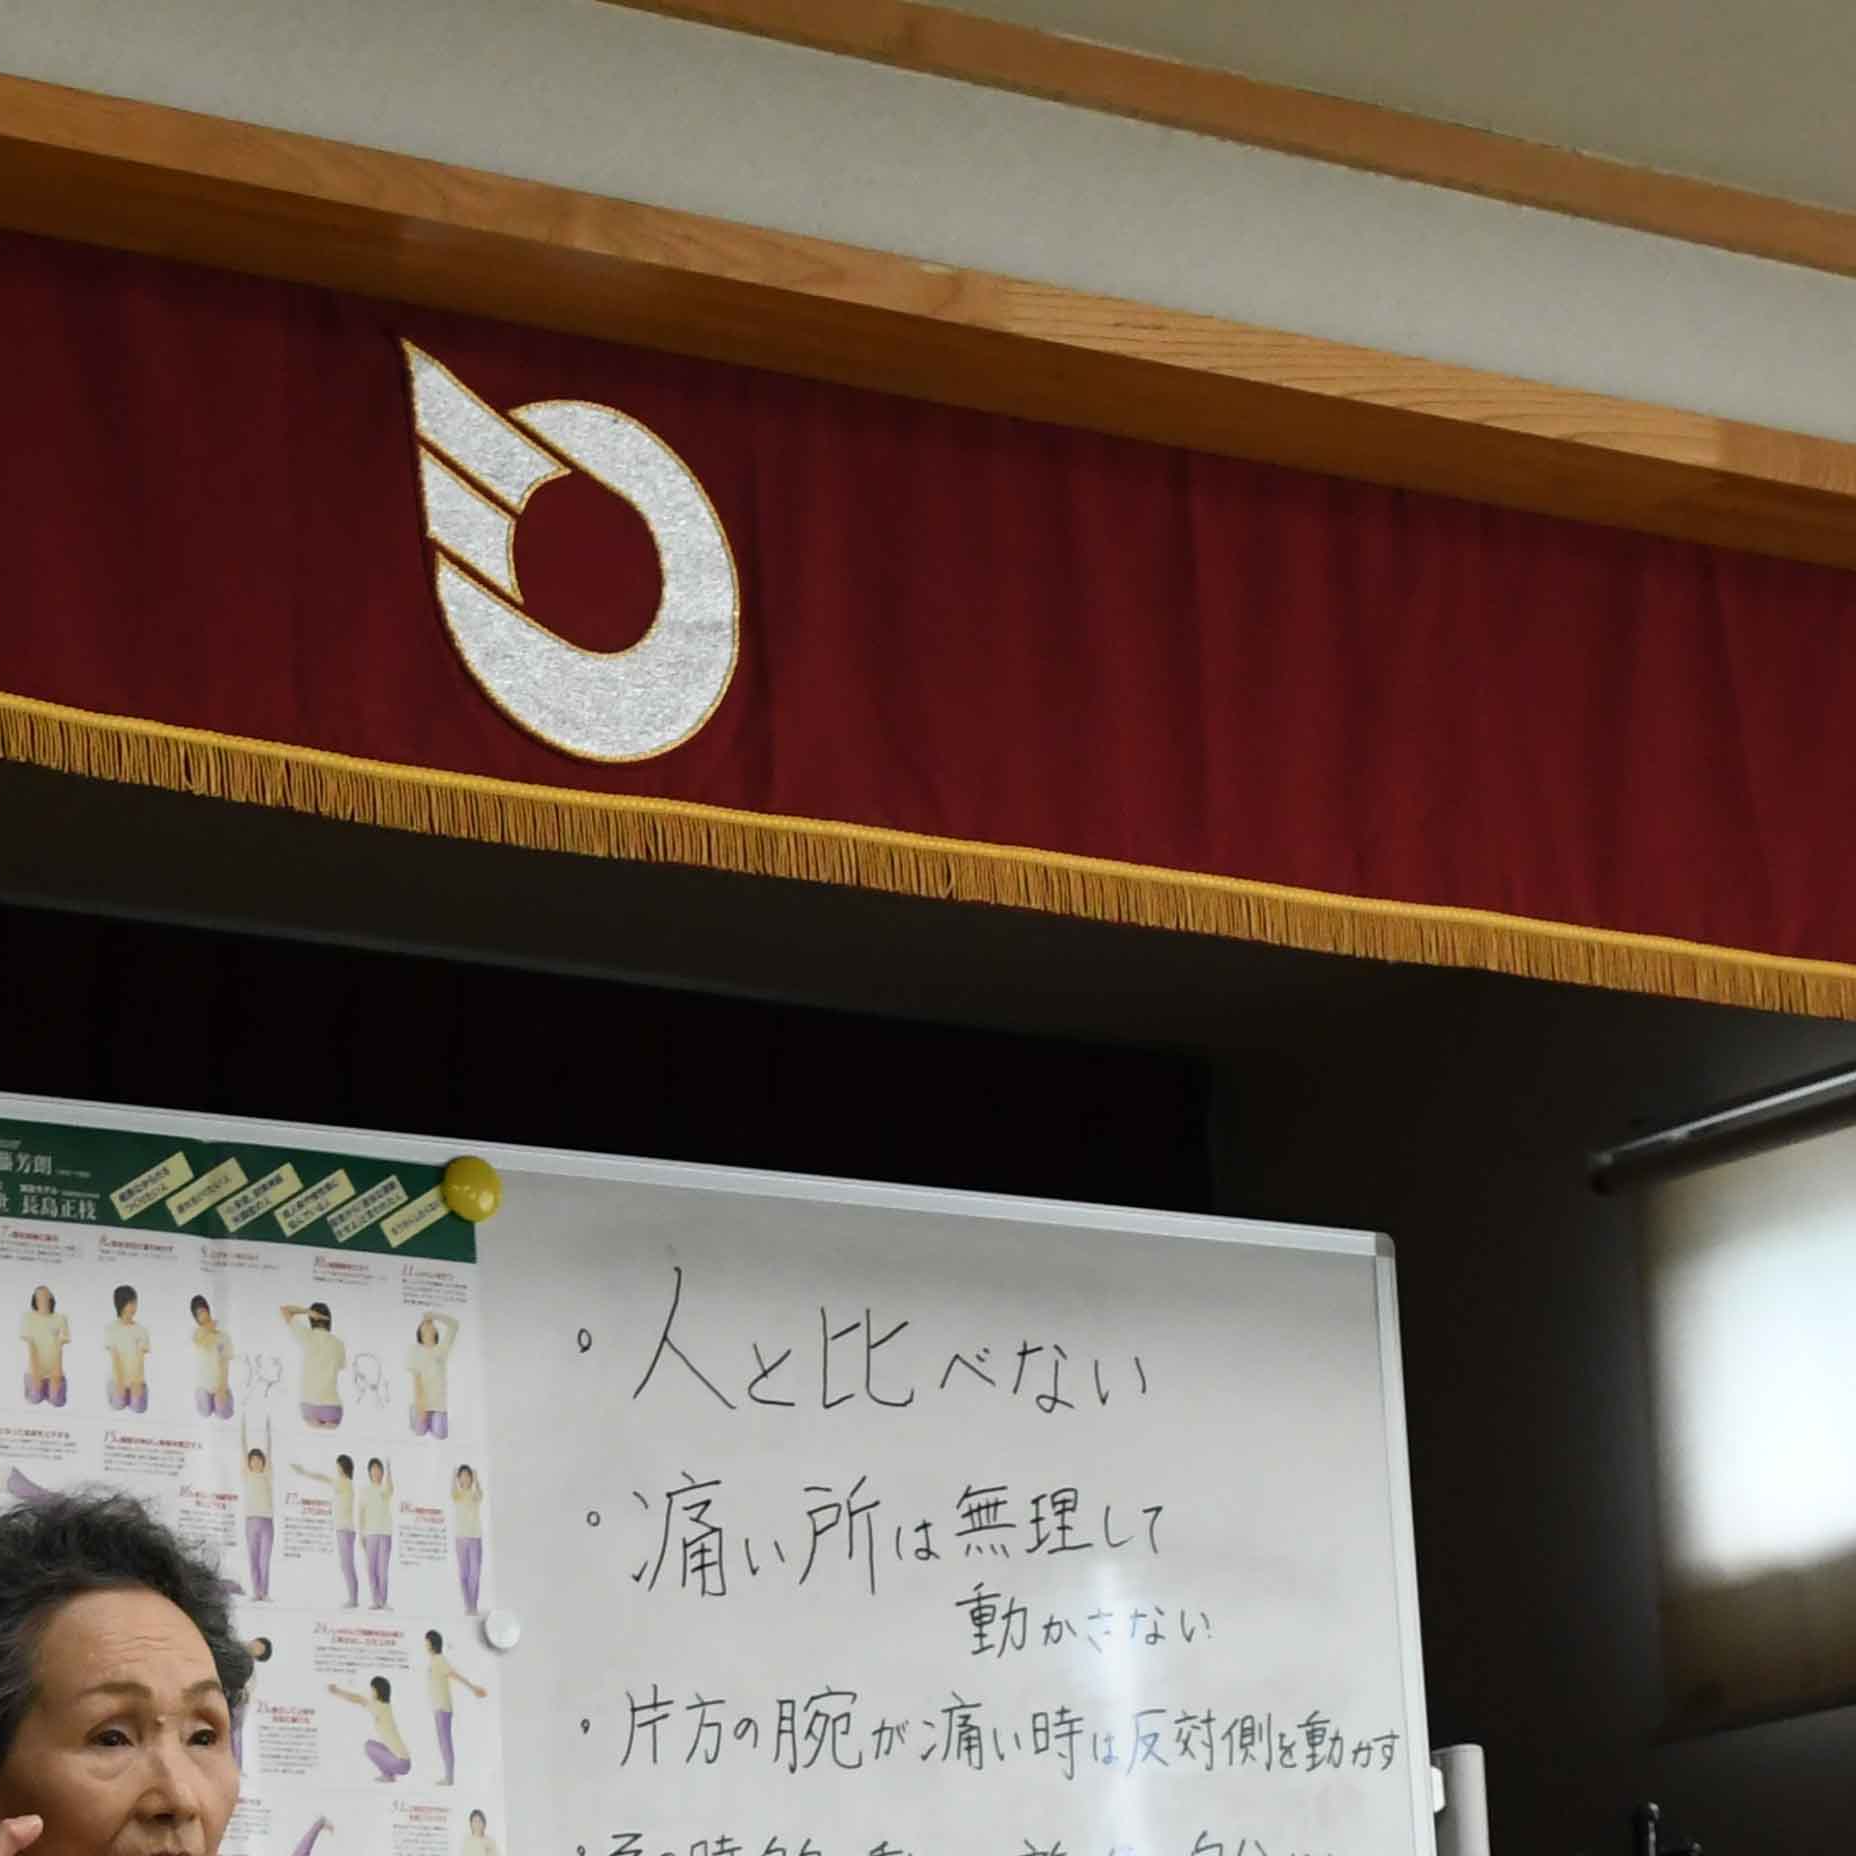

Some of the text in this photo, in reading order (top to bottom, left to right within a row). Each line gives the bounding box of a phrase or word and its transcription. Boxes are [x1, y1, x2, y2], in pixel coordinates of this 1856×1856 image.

[956, 1582, 1214, 1659] 動かさない
